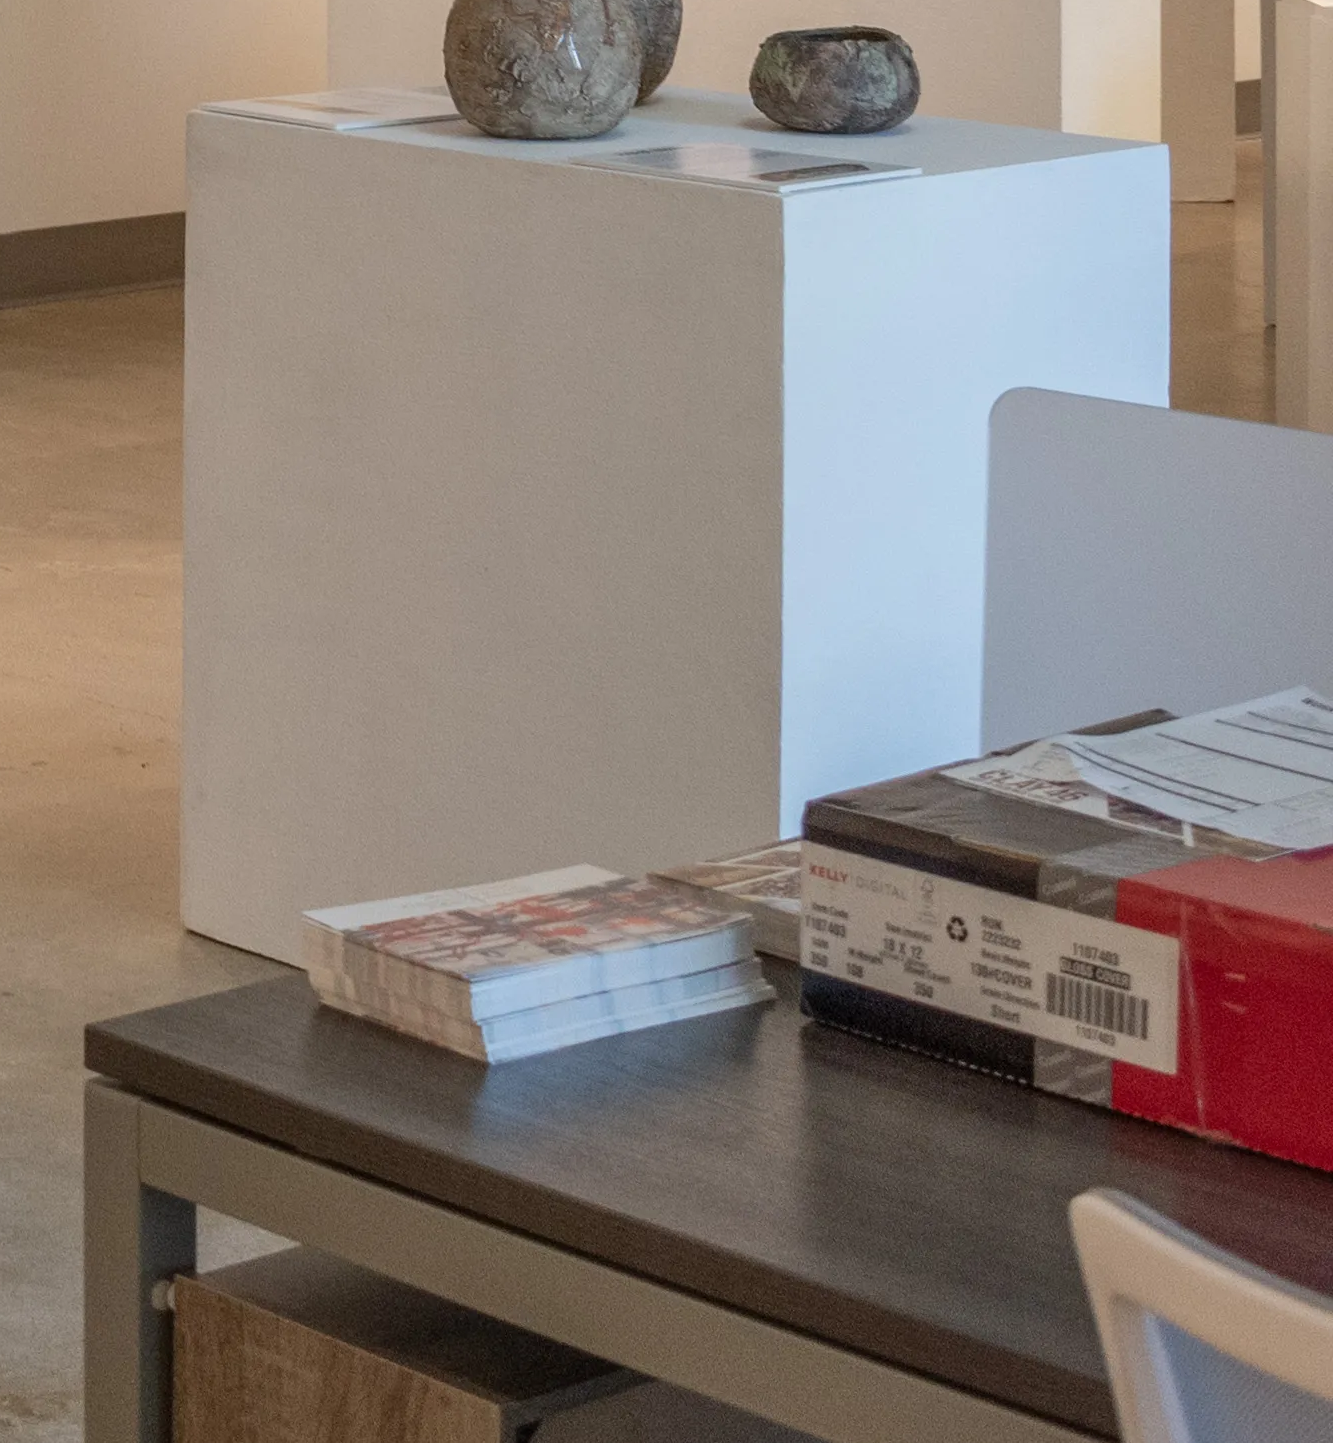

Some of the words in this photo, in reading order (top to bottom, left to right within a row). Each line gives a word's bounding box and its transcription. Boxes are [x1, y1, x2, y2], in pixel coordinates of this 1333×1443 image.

[809, 864, 848, 884] KELLY
[856, 875, 908, 901] DIGITAL
[1096, 967, 1130, 988] COVER
